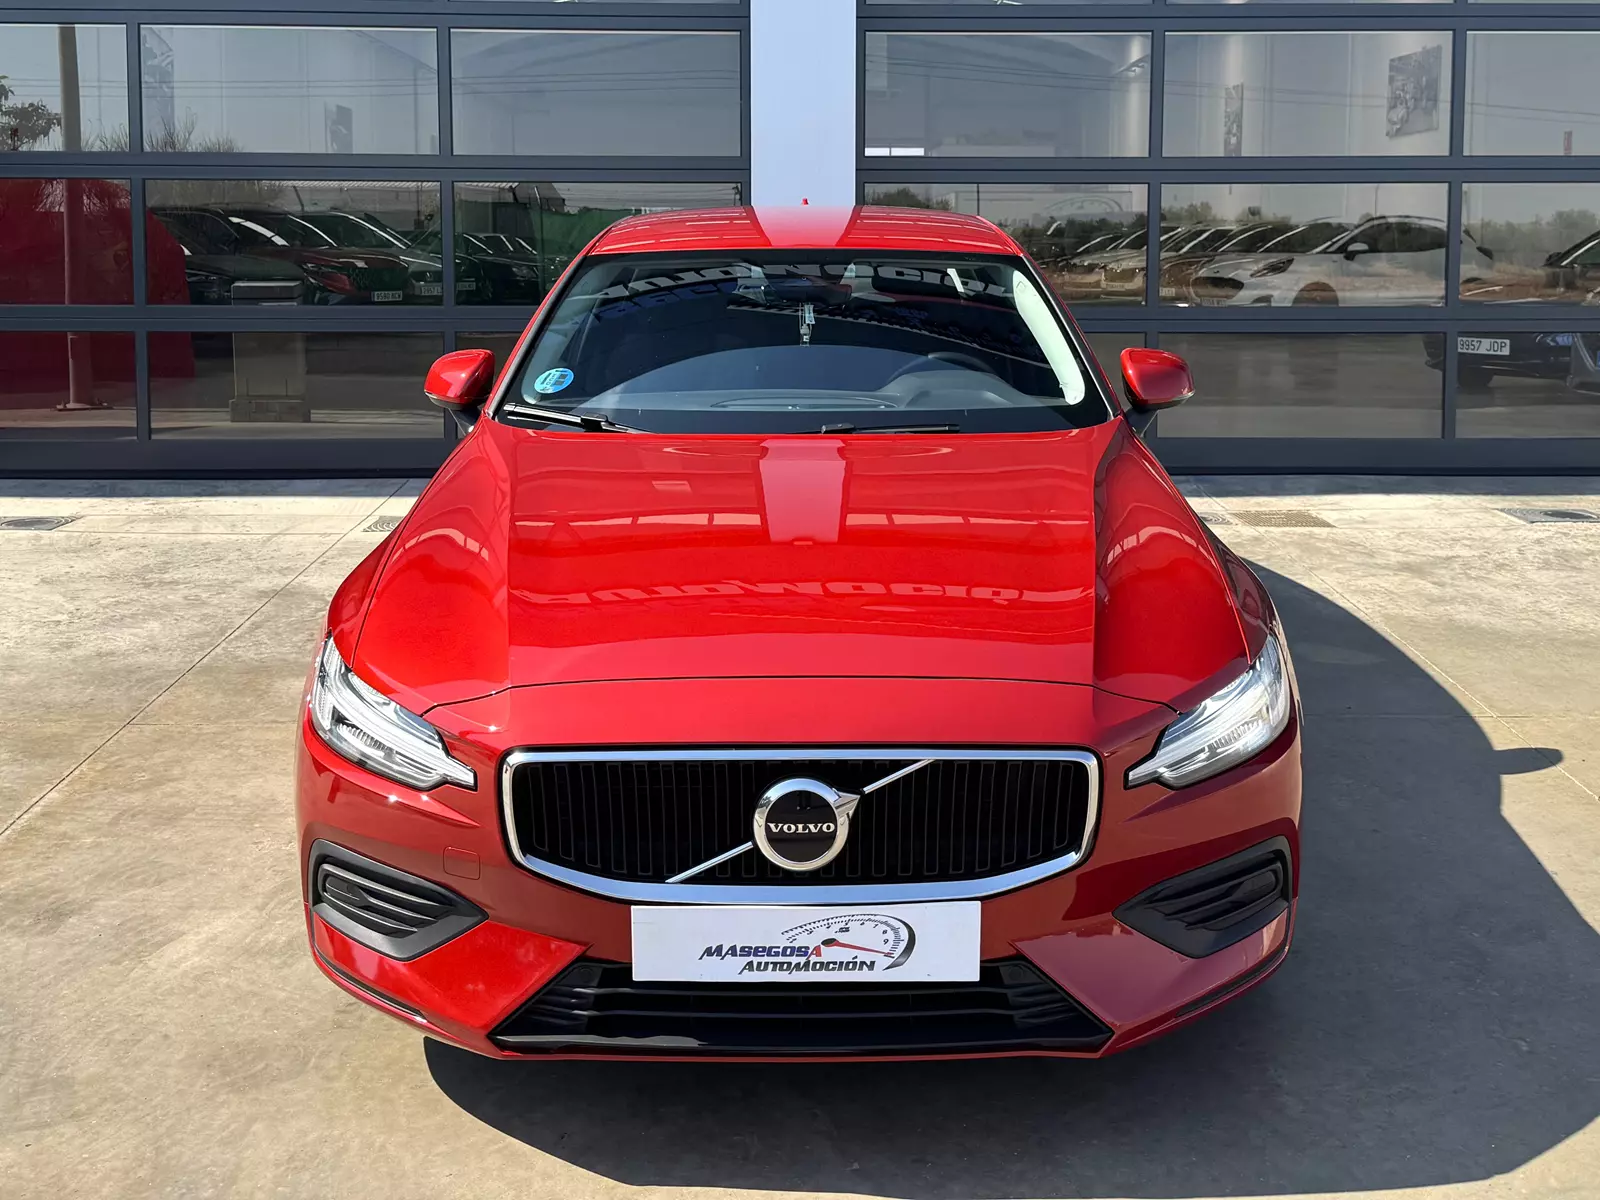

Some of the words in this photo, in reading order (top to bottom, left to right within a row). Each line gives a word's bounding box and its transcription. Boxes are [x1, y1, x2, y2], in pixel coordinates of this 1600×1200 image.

[1459, 338, 1482, 351] 9957
[1485, 340, 1507, 353] JDP
[767, 822, 836, 834] VOLVO
[738, 955, 876, 975] AUTOMOCIÓN
